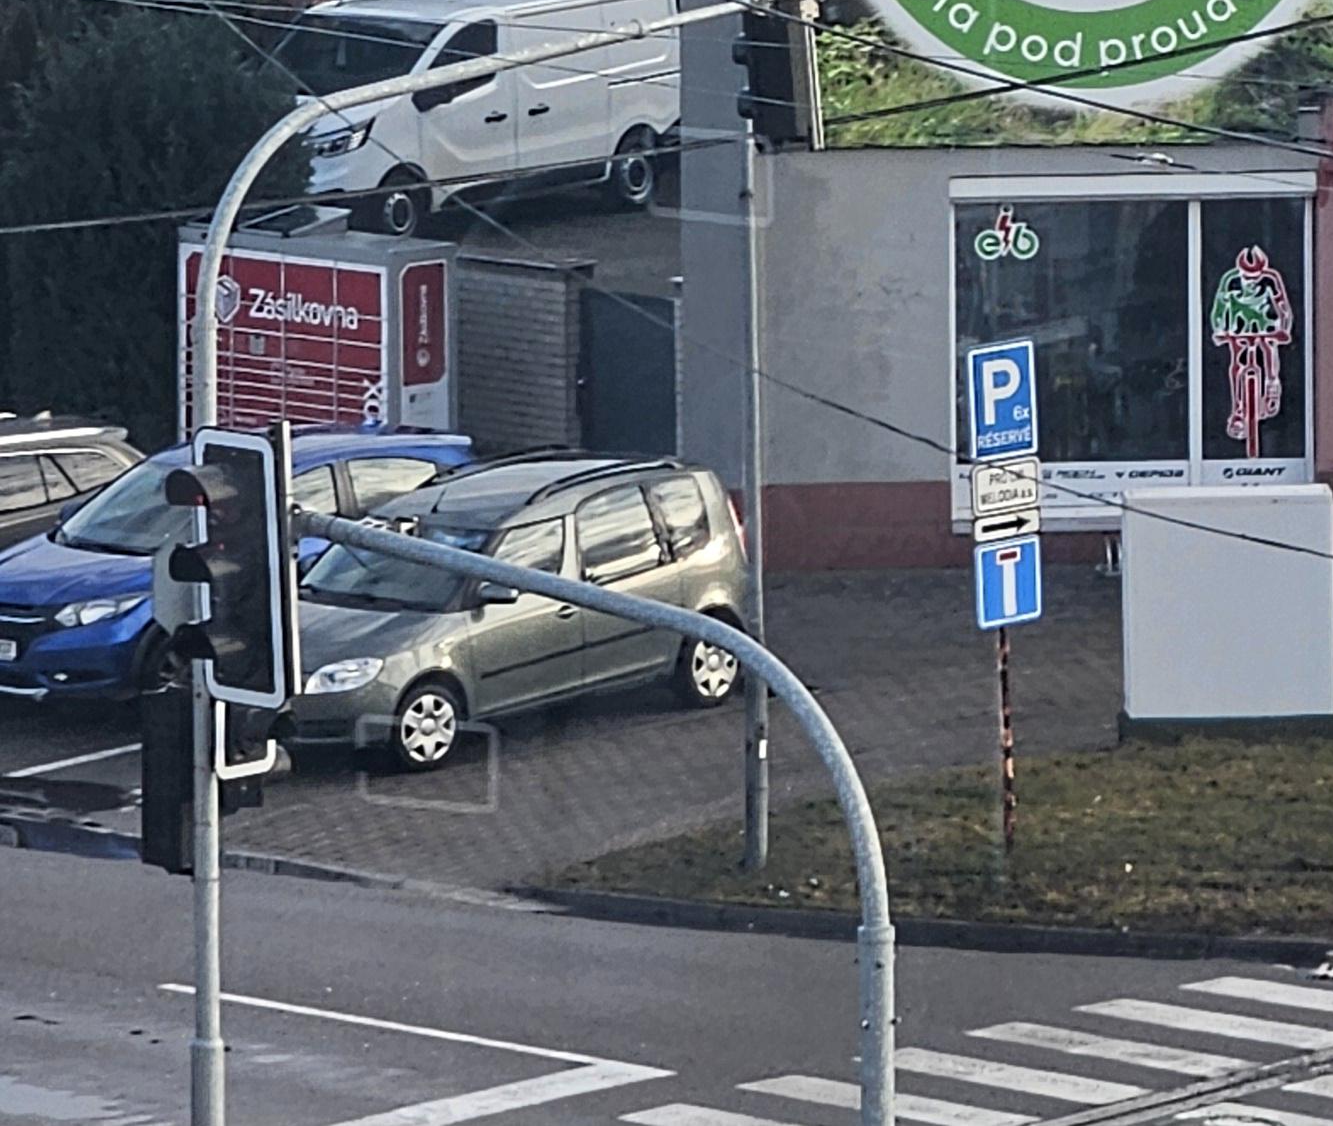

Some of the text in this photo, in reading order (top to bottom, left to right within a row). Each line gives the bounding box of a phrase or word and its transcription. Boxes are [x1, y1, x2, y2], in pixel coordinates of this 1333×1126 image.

[983, 22, 1082, 68] pod
[249, 288, 359, 330] Zásilkovna
[982, 358, 1021, 426] P
[1012, 404, 1031, 421] 6x
[977, 425, 1032, 450] RÉSERVÉ
[1235, 466, 1286, 477] GIANT
